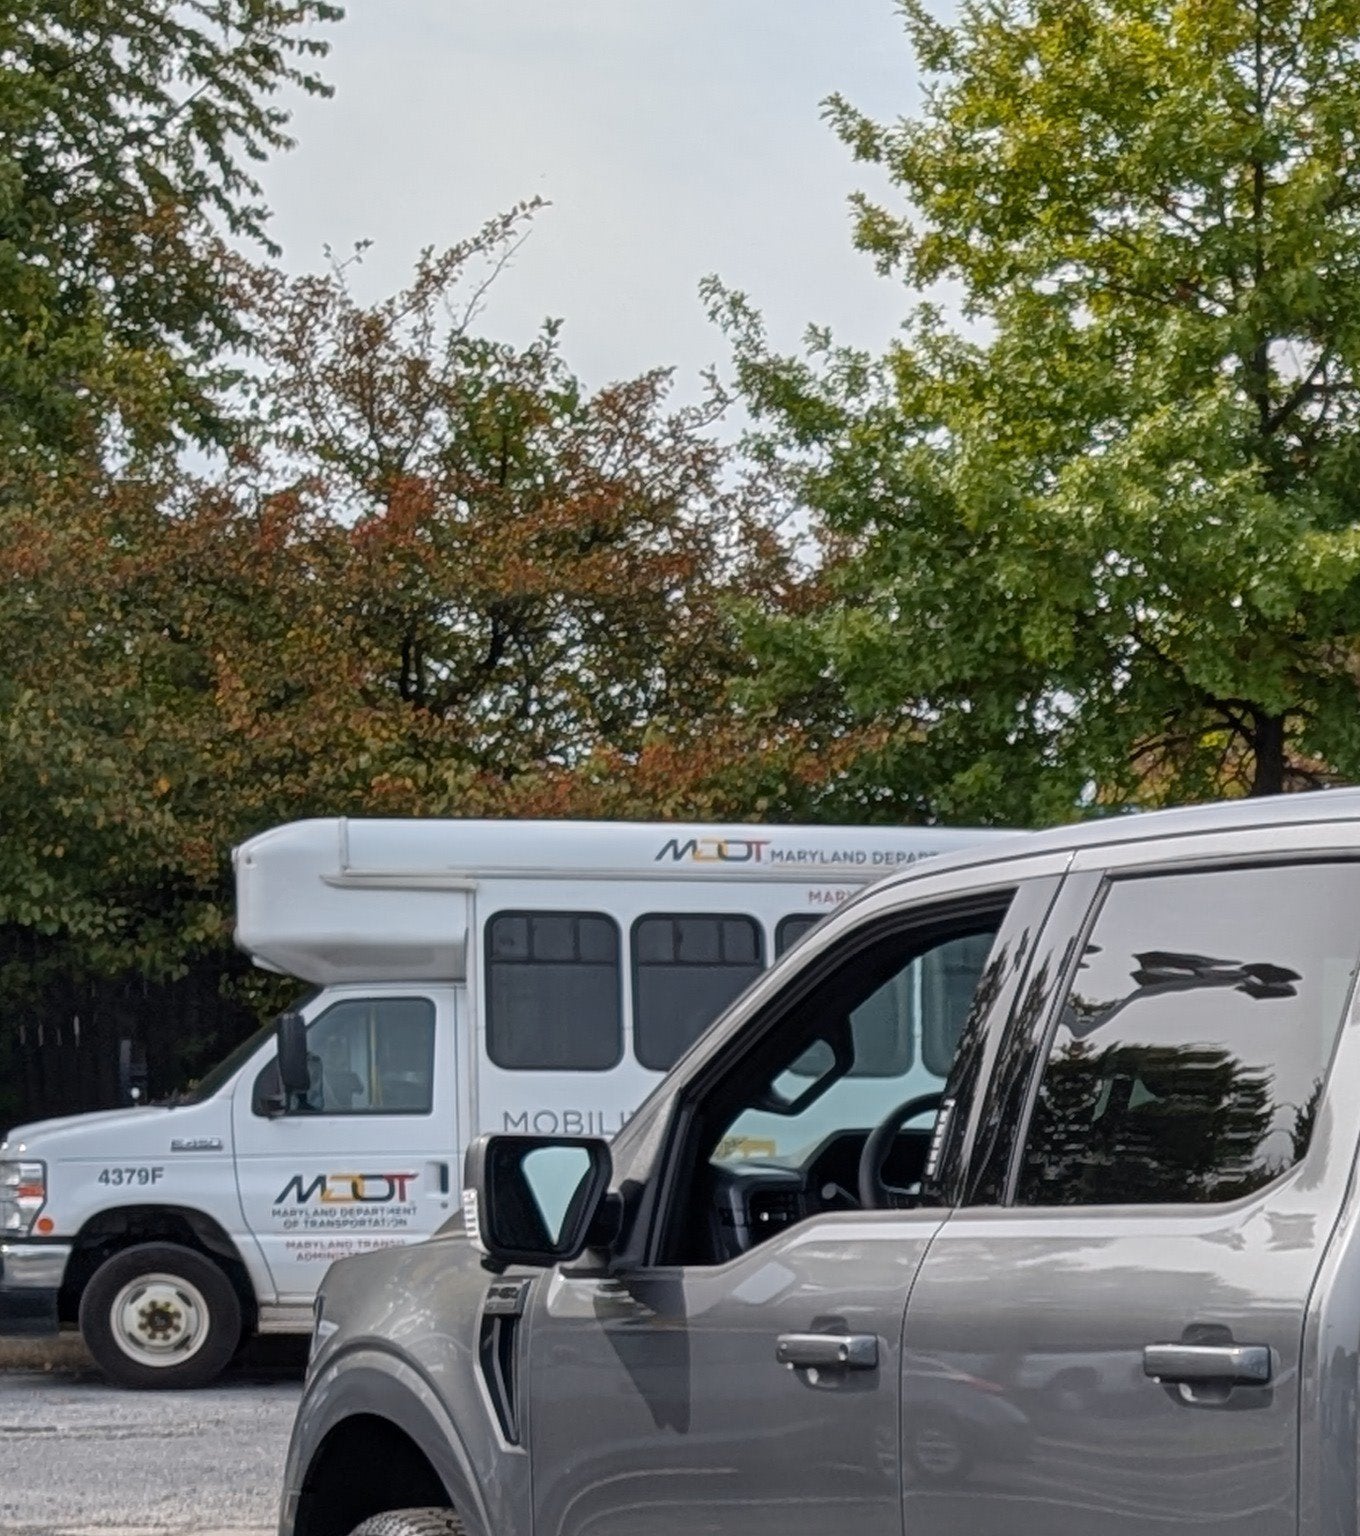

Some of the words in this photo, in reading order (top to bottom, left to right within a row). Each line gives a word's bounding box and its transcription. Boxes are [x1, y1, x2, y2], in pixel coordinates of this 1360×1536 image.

[771, 850, 866, 865] MARYLAND
[98, 1167, 164, 1186] 4379F
[272, 1208, 336, 1218] MARYLAND
[340, 1206, 417, 1217] DEPARTMENT
[283, 1220, 299, 1229] OF
[286, 1240, 352, 1250] MARYLAND
